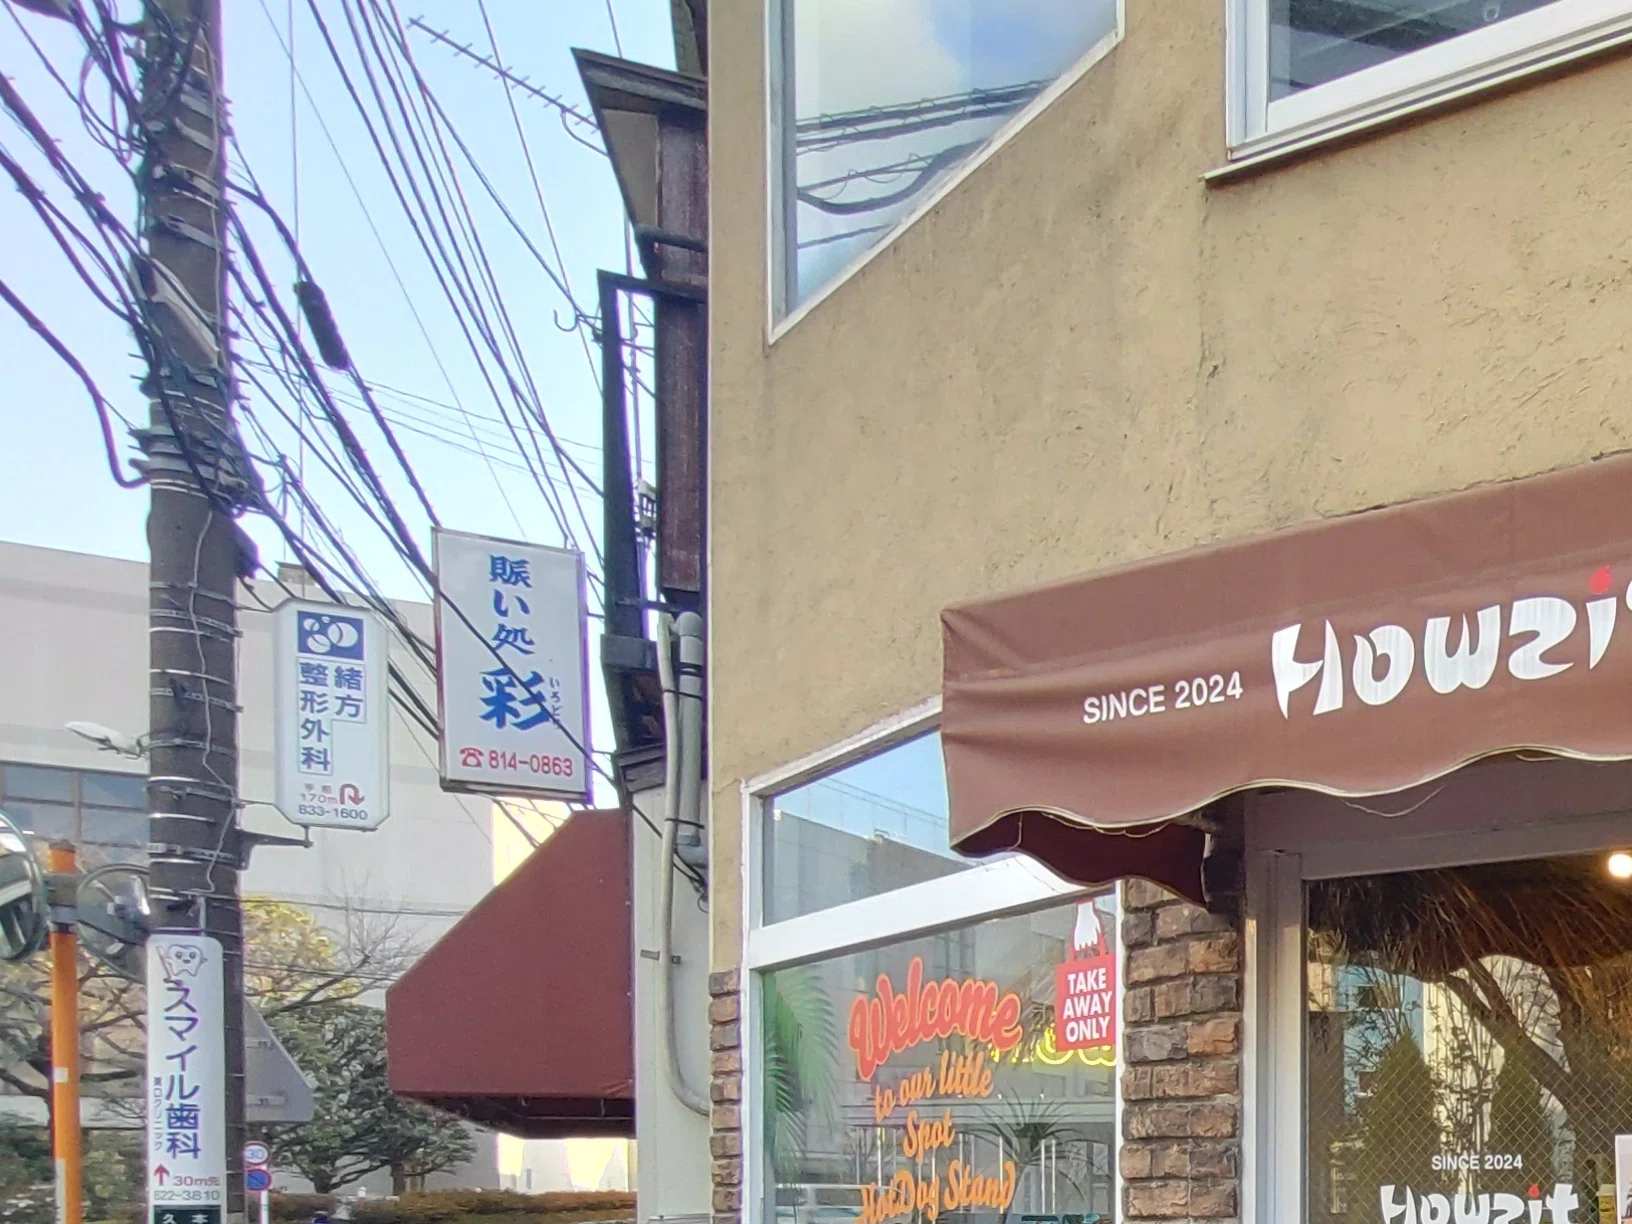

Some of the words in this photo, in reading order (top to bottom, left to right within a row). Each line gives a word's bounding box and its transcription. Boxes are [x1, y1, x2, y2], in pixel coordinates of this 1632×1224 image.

[488, 554, 535, 655] 賑い処
[299, 661, 330, 772] 整形外科
[334, 665, 364, 718] 緒方
[479, 667, 551, 731] 彩
[1083, 684, 1166, 724] SINCE
[1174, 671, 1243, 709] 2024
[488, 749, 574, 777] 814-0863
[1062, 990, 1113, 1021] AWAY
[1067, 967, 1107, 995] TAKE
[849, 956, 1023, 1082] Welcome
[1065, 1015, 1111, 1043] ONLY
[164, 984, 203, 1160] スマイル歯科
[874, 1085, 897, 1122] to
[899, 1067, 937, 1102] our
[938, 1049, 994, 1098] little
[902, 1110, 956, 1165] Spot
[1431, 1155, 1480, 1170] SINCE
[1484, 1154, 1524, 1170] 2024
[944, 1158, 1017, 1211] Stand
